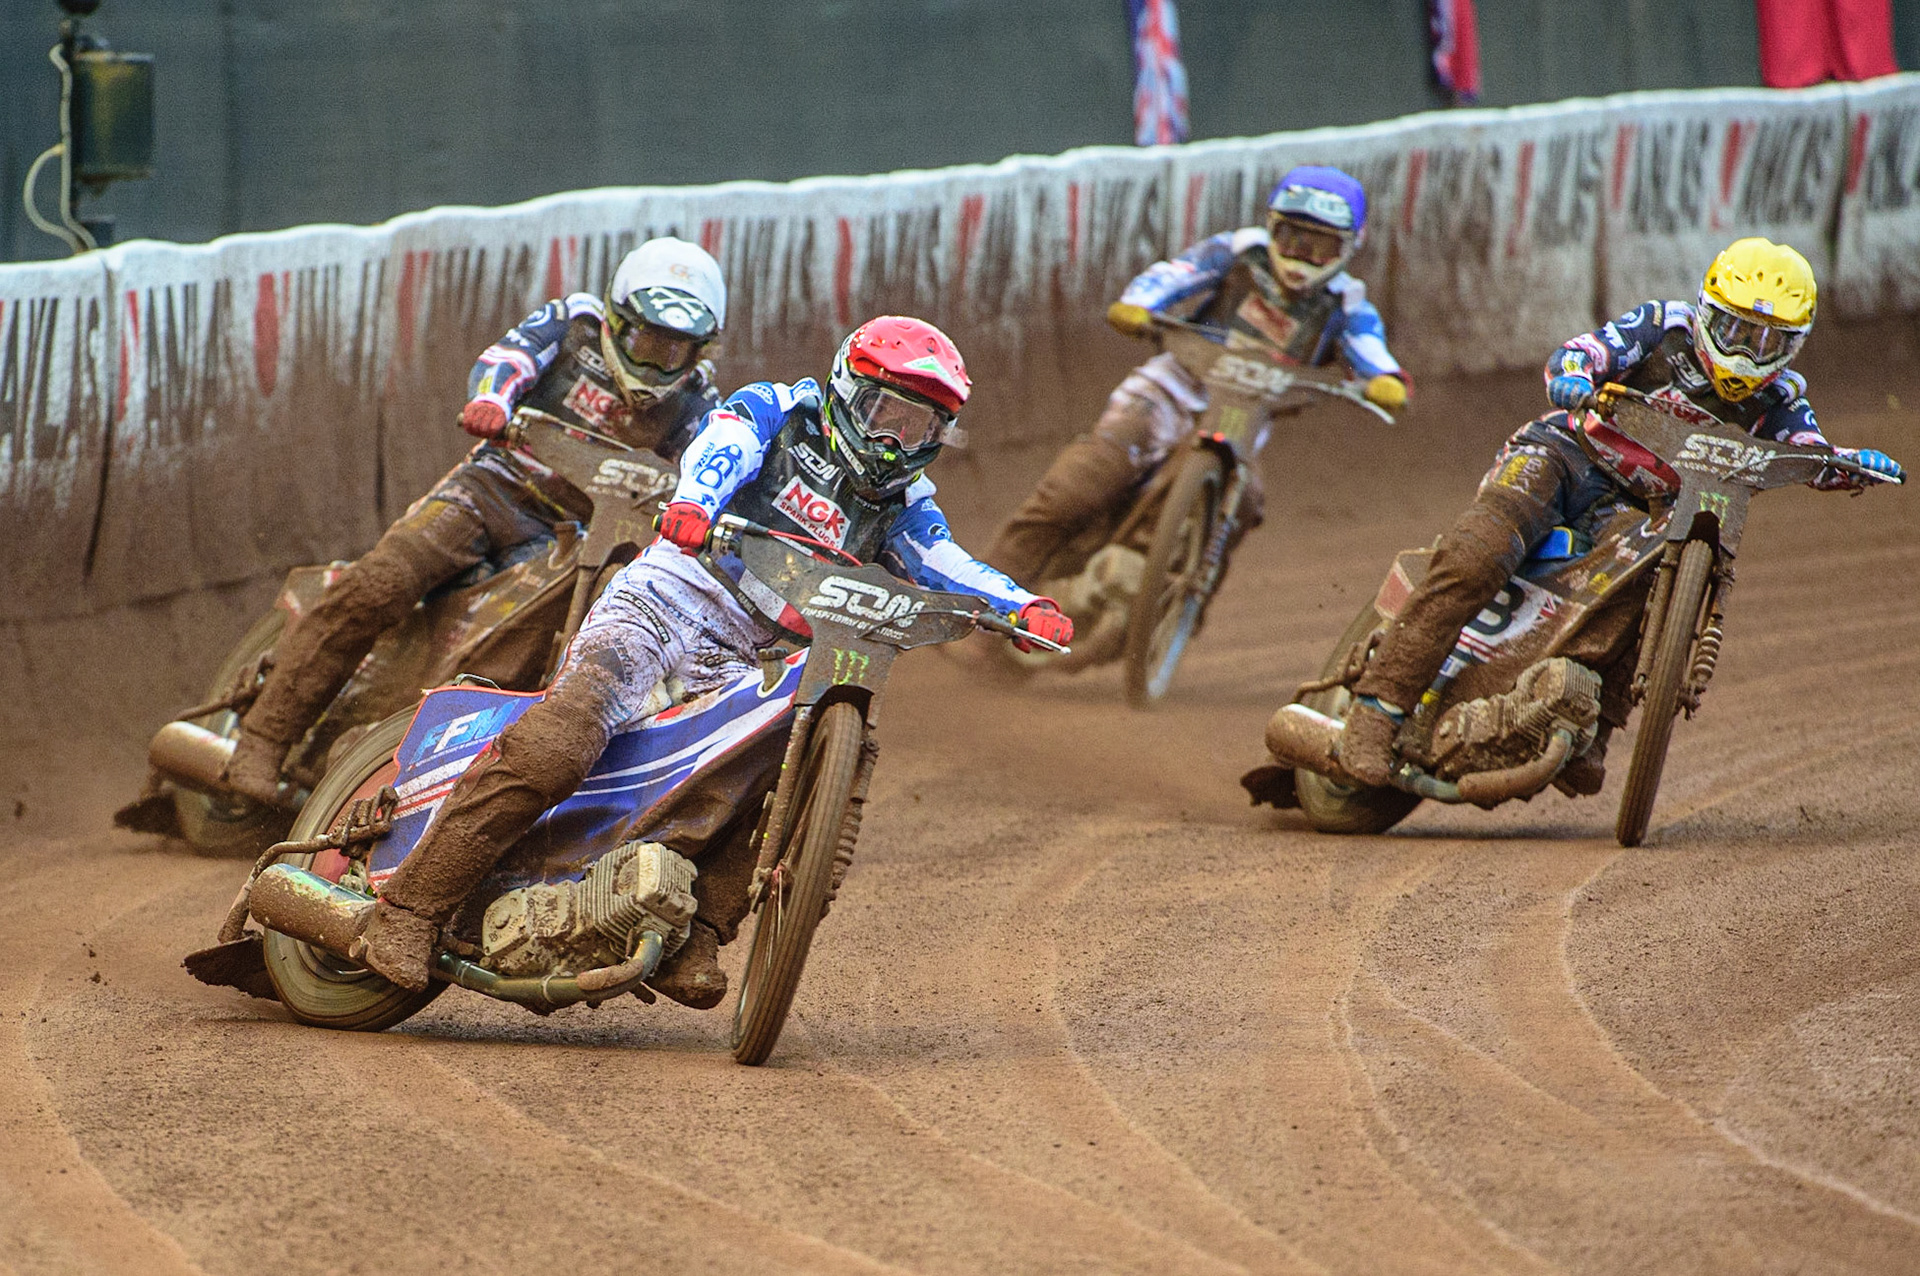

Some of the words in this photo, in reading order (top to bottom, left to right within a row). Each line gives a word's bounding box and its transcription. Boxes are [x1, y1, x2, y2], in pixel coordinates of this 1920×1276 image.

[780, 501, 807, 526] SPARK
[808, 523, 836, 548] PLUGS
[785, 482, 845, 539] NGK
